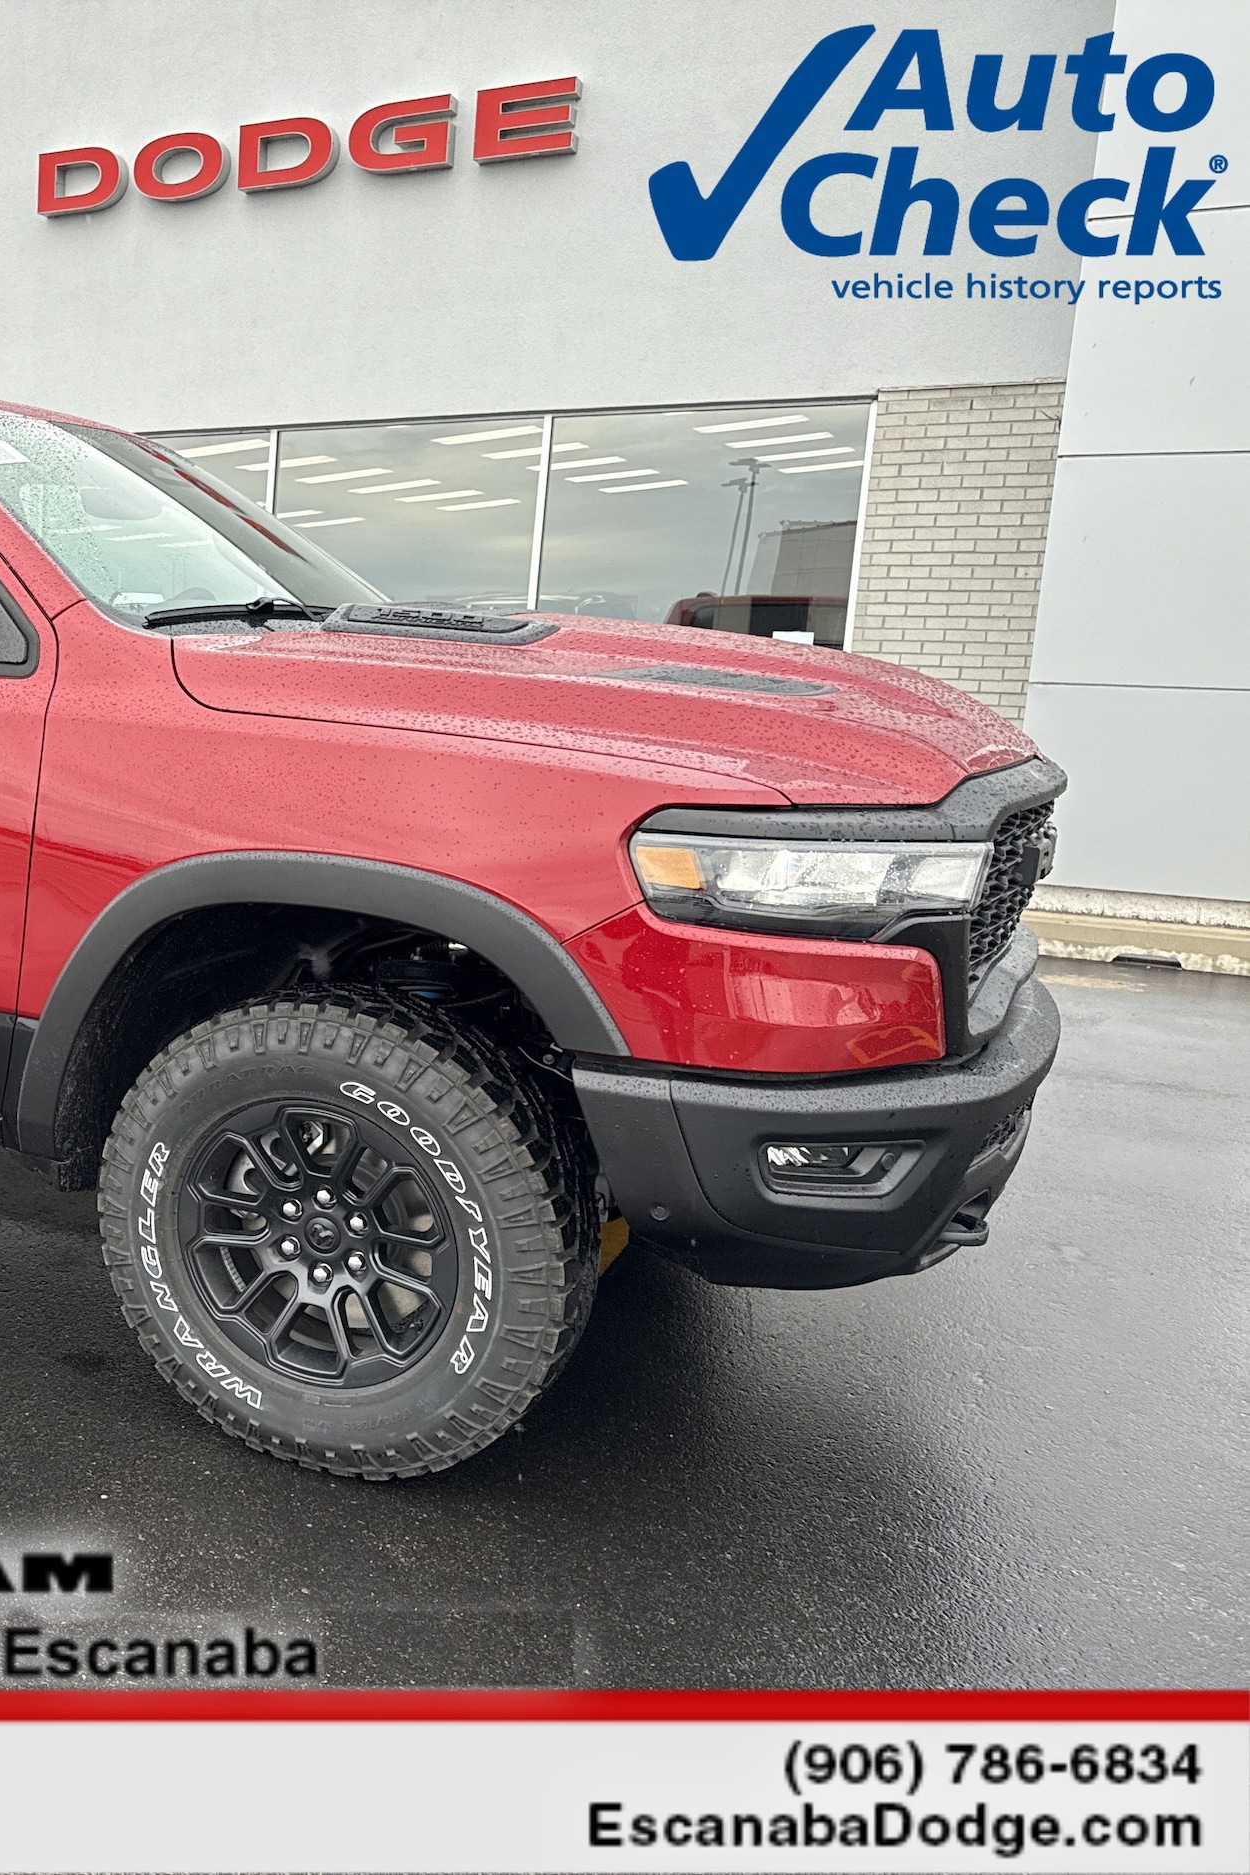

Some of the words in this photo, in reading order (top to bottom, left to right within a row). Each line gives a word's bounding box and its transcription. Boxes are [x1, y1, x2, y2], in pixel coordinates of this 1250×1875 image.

[36, 76, 582, 219] DODGE
[137, 1141, 263, 1410] WRANGLER
[339, 1081, 493, 1375] GOODYEAR
